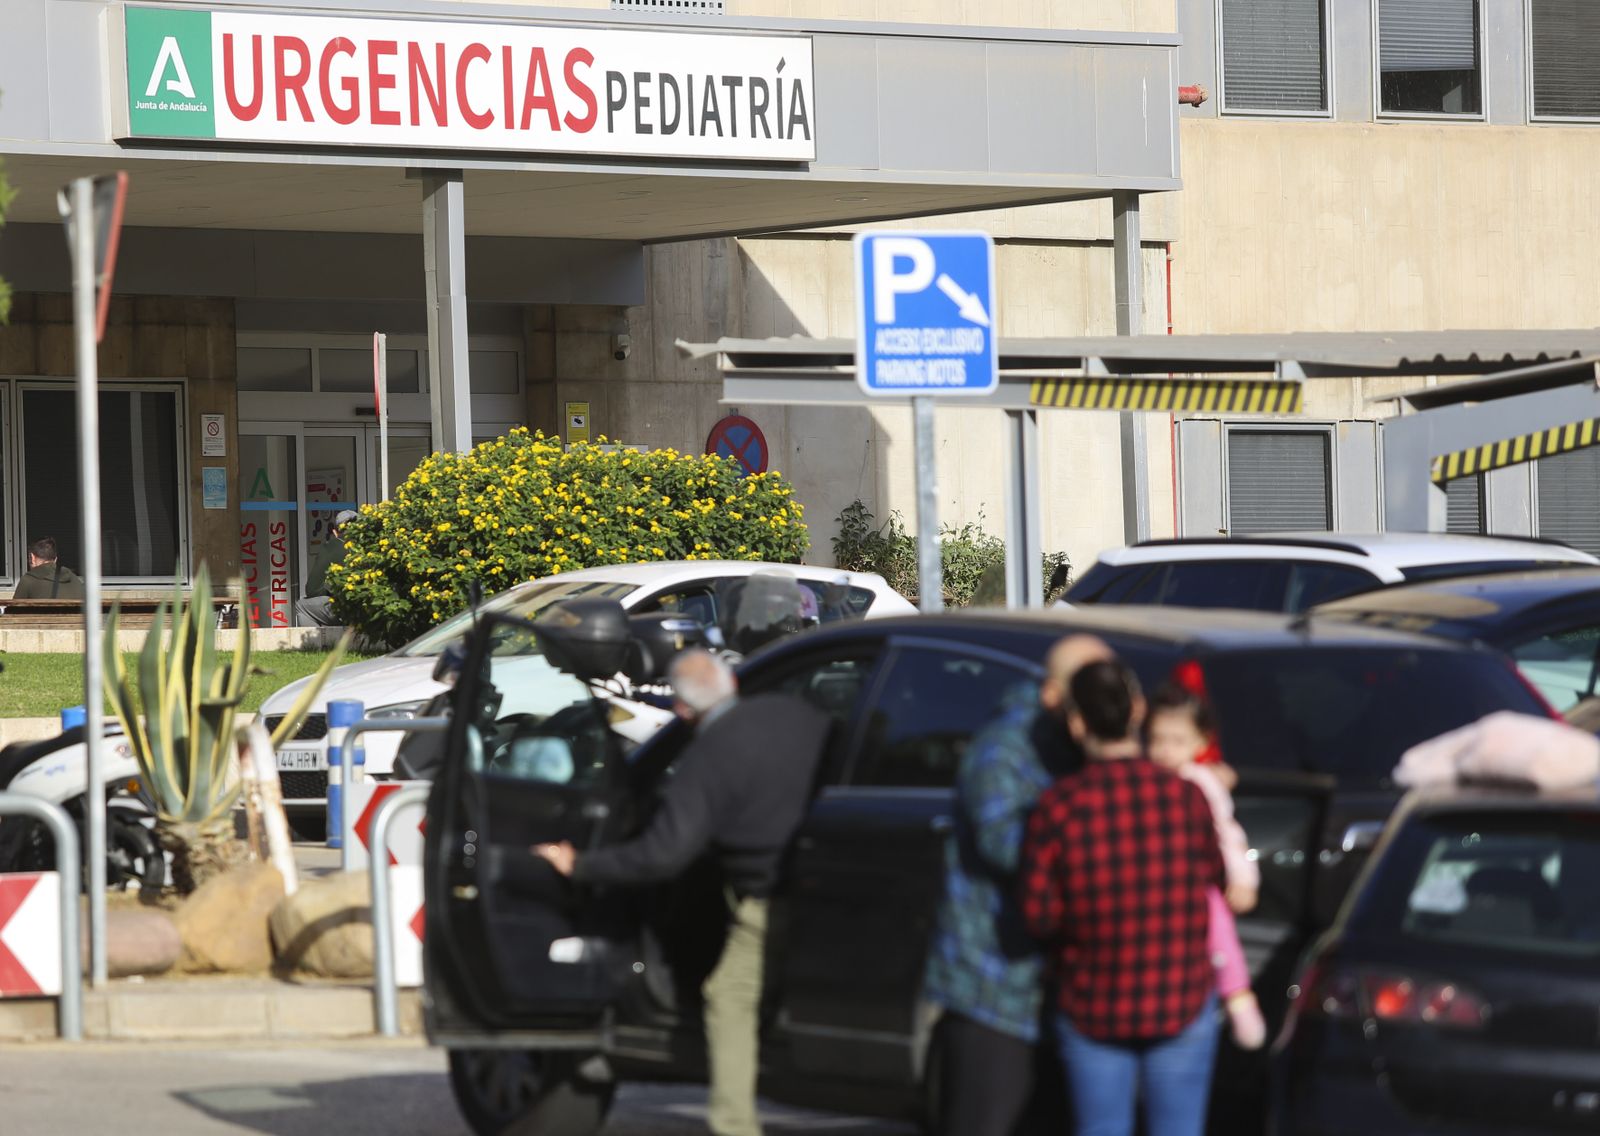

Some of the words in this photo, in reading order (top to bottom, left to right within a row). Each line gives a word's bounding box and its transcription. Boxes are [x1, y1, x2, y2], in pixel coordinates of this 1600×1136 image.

[222, 33, 598, 135] URGENCIAS
[606, 56, 811, 141] PEDIATRÍA
[135, 101, 157, 110] Junta
[158, 101, 169, 111] de
[169, 102, 208, 112] Andalucía
[873, 238, 936, 324] P
[875, 327, 921, 355] ACCESO
[921, 327, 985, 355] EXCLUSIVO
[875, 358, 926, 386] PARKING
[927, 358, 967, 386] MOTOS
[240, 522, 260, 628] ENCIAS
[296, 751, 317, 768] HRW
